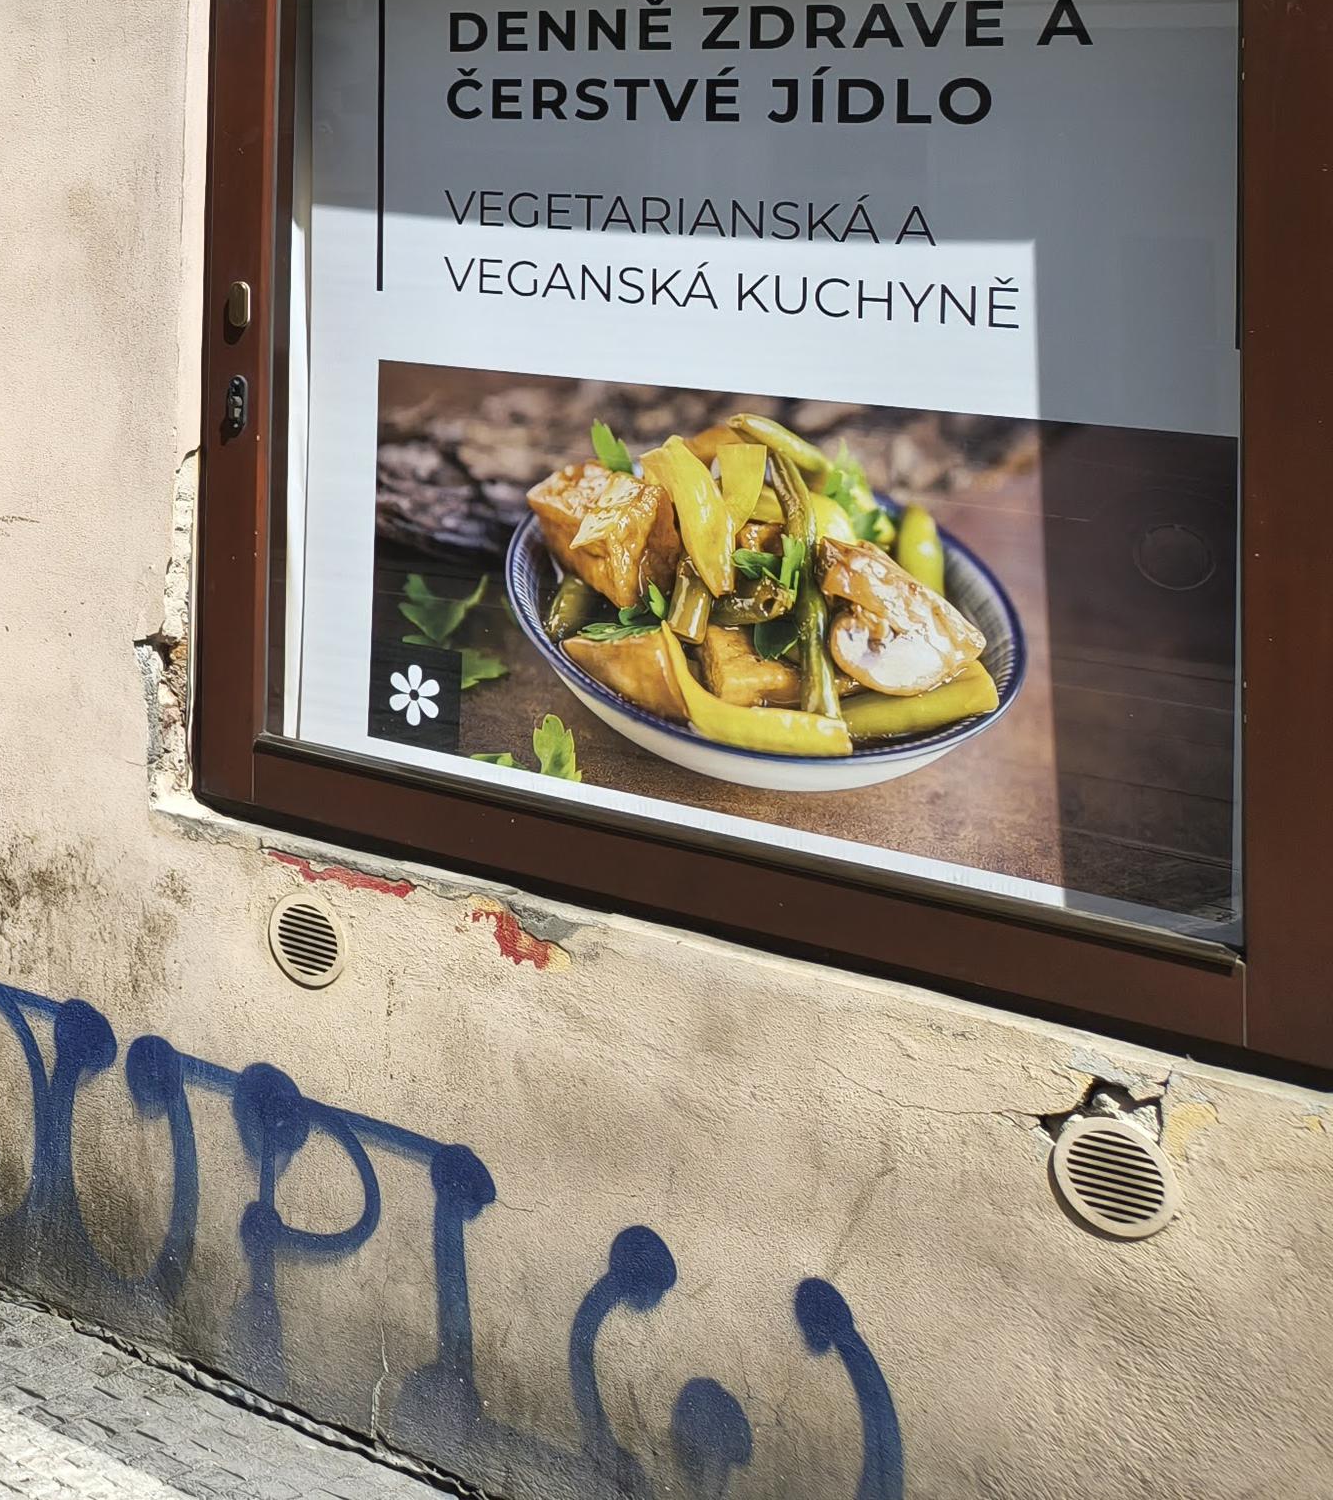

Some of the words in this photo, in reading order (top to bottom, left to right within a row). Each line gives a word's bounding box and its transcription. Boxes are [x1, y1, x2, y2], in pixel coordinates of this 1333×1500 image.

[446, 68, 742, 122] ČERSTVÉ
[767, 67, 993, 125] JÍDLO
[445, 189, 879, 245] VEGETARIANSKÁ
[896, 205, 936, 247] A
[445, 256, 718, 310] VEGANSKÁ
[736, 272, 1021, 330] KUCHYNĚ
